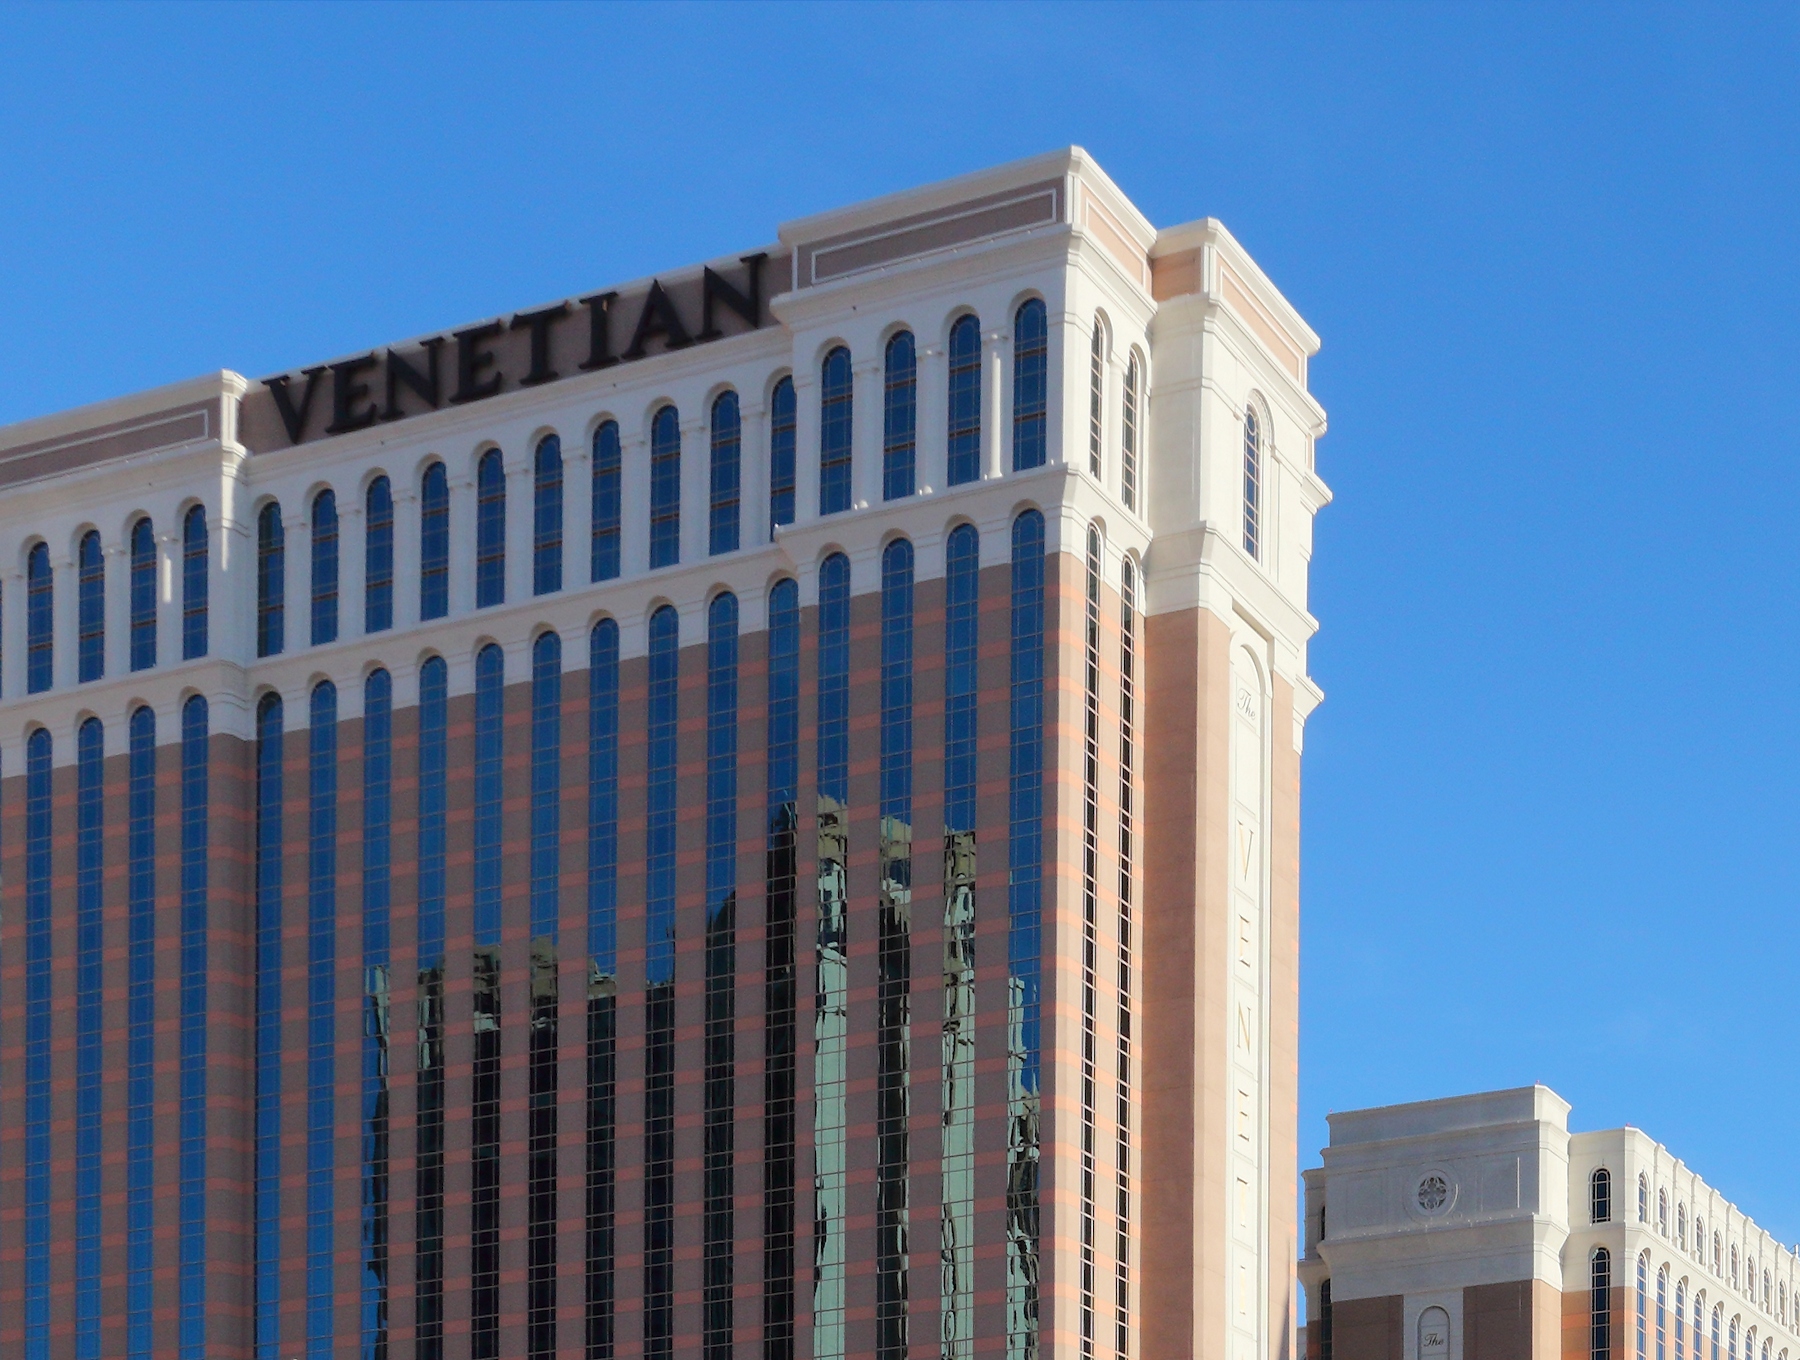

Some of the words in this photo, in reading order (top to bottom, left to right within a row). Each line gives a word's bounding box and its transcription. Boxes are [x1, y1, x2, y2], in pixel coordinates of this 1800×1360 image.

[261, 252, 768, 445] VENETIAN
[1237, 687, 1256, 720] The
[1424, 1333, 1445, 1348] The
